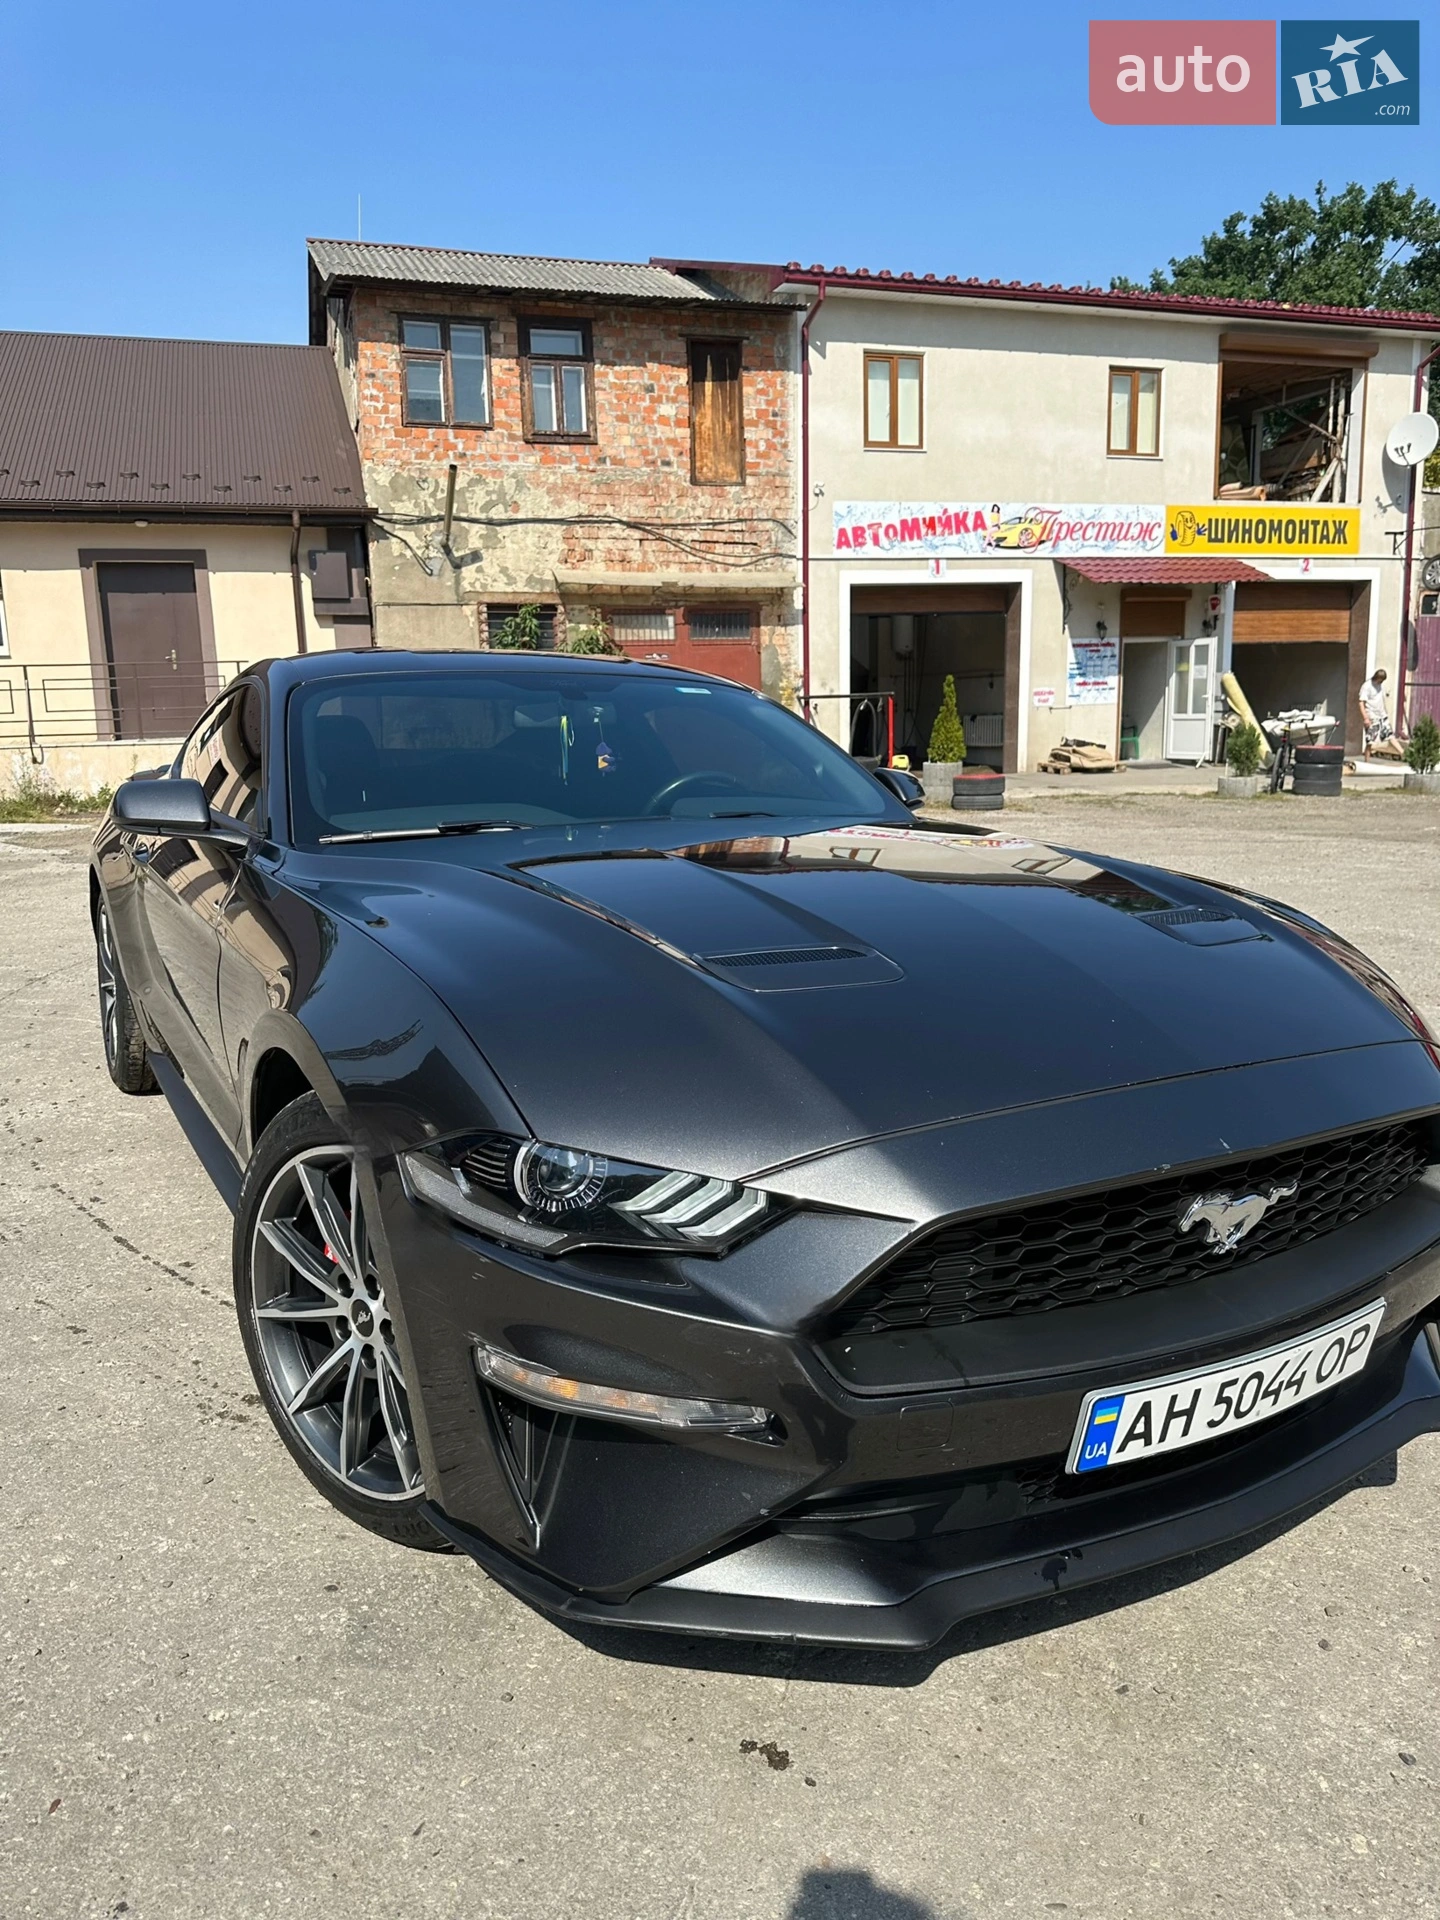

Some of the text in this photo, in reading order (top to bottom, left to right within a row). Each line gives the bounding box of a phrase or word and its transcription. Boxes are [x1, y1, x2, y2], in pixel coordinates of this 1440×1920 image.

[836, 506, 1162, 554] АВТОМИЙКА Престиж
[1207, 518, 1349, 545] ШИНОМОНТАЖ
[934, 558, 940, 575] 1
[1302, 558, 1310, 572] 2
[1116, 1323, 1371, 1454] AH 5044 OP
[1085, 1443, 1108, 1460] UA
